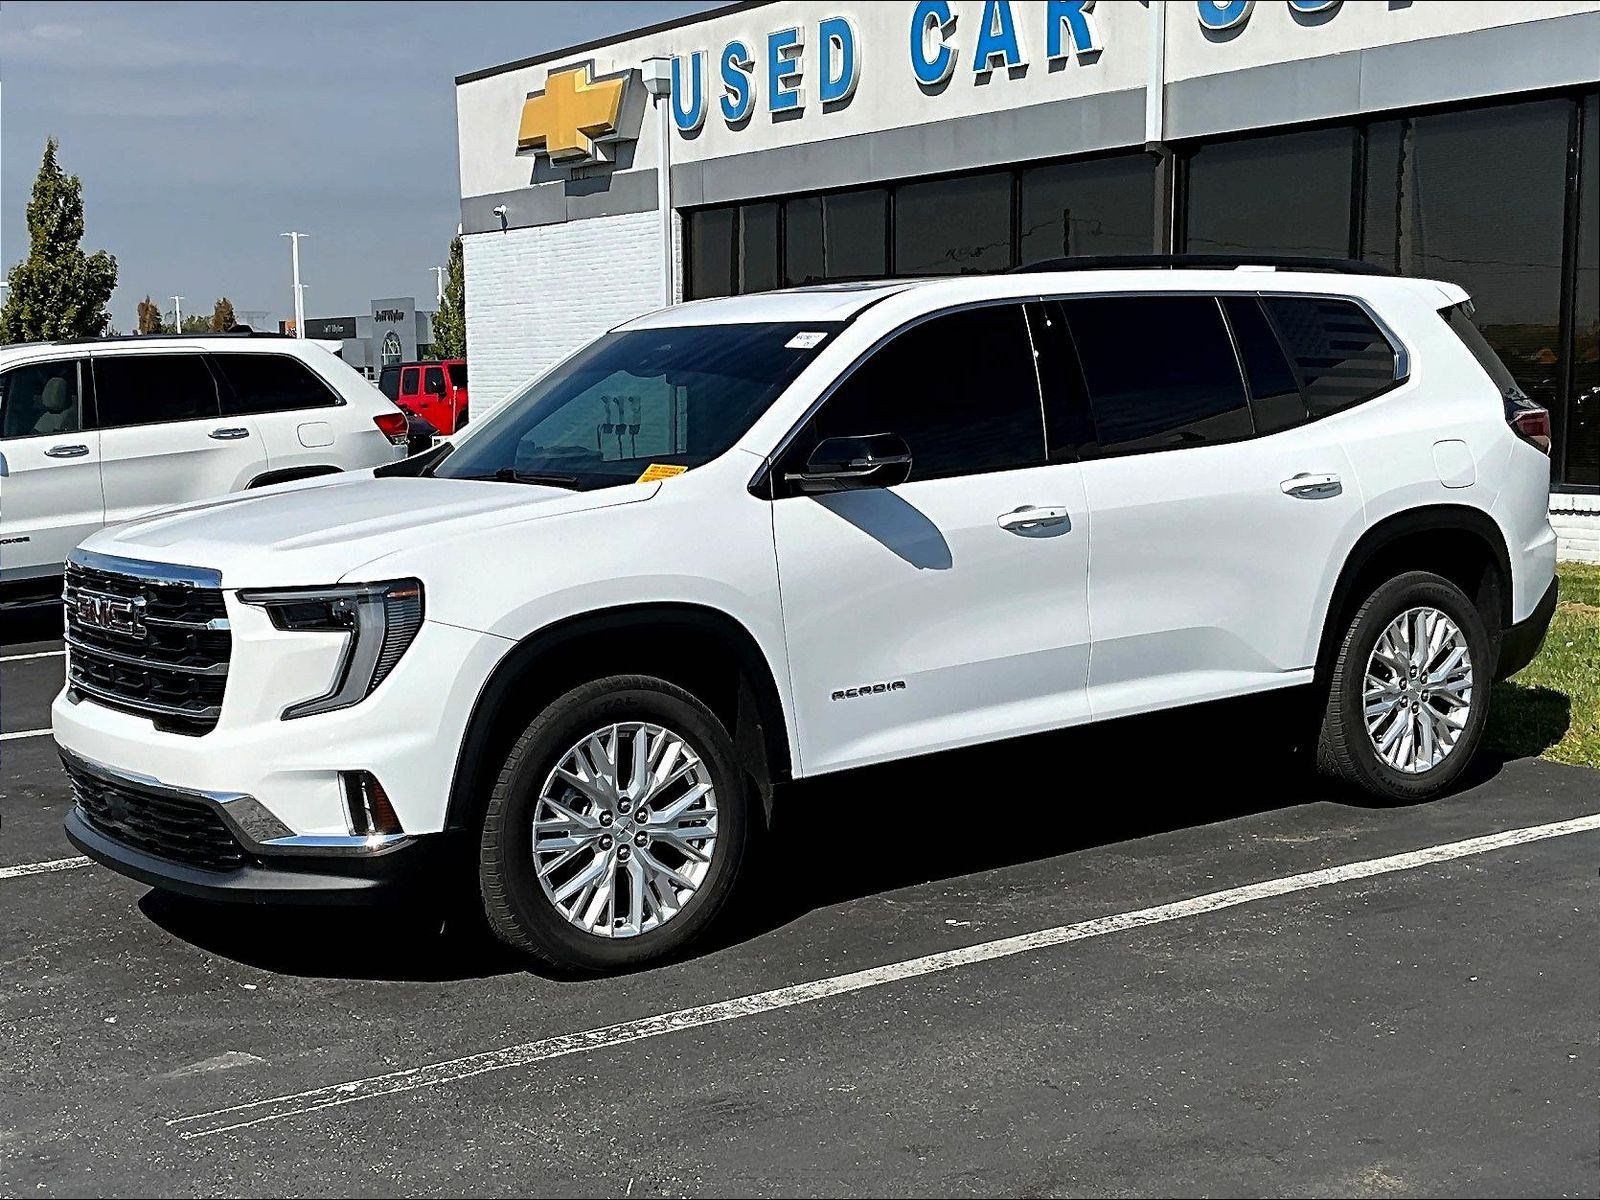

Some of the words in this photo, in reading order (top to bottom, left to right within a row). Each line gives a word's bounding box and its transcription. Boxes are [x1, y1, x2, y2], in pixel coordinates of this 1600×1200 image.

[670, 15, 860, 132] USED
[907, 0, 1105, 85] CAR
[0, 536, 30, 545] OKEE
[77, 592, 143, 637] GMC
[831, 680, 907, 701] ACADIA
